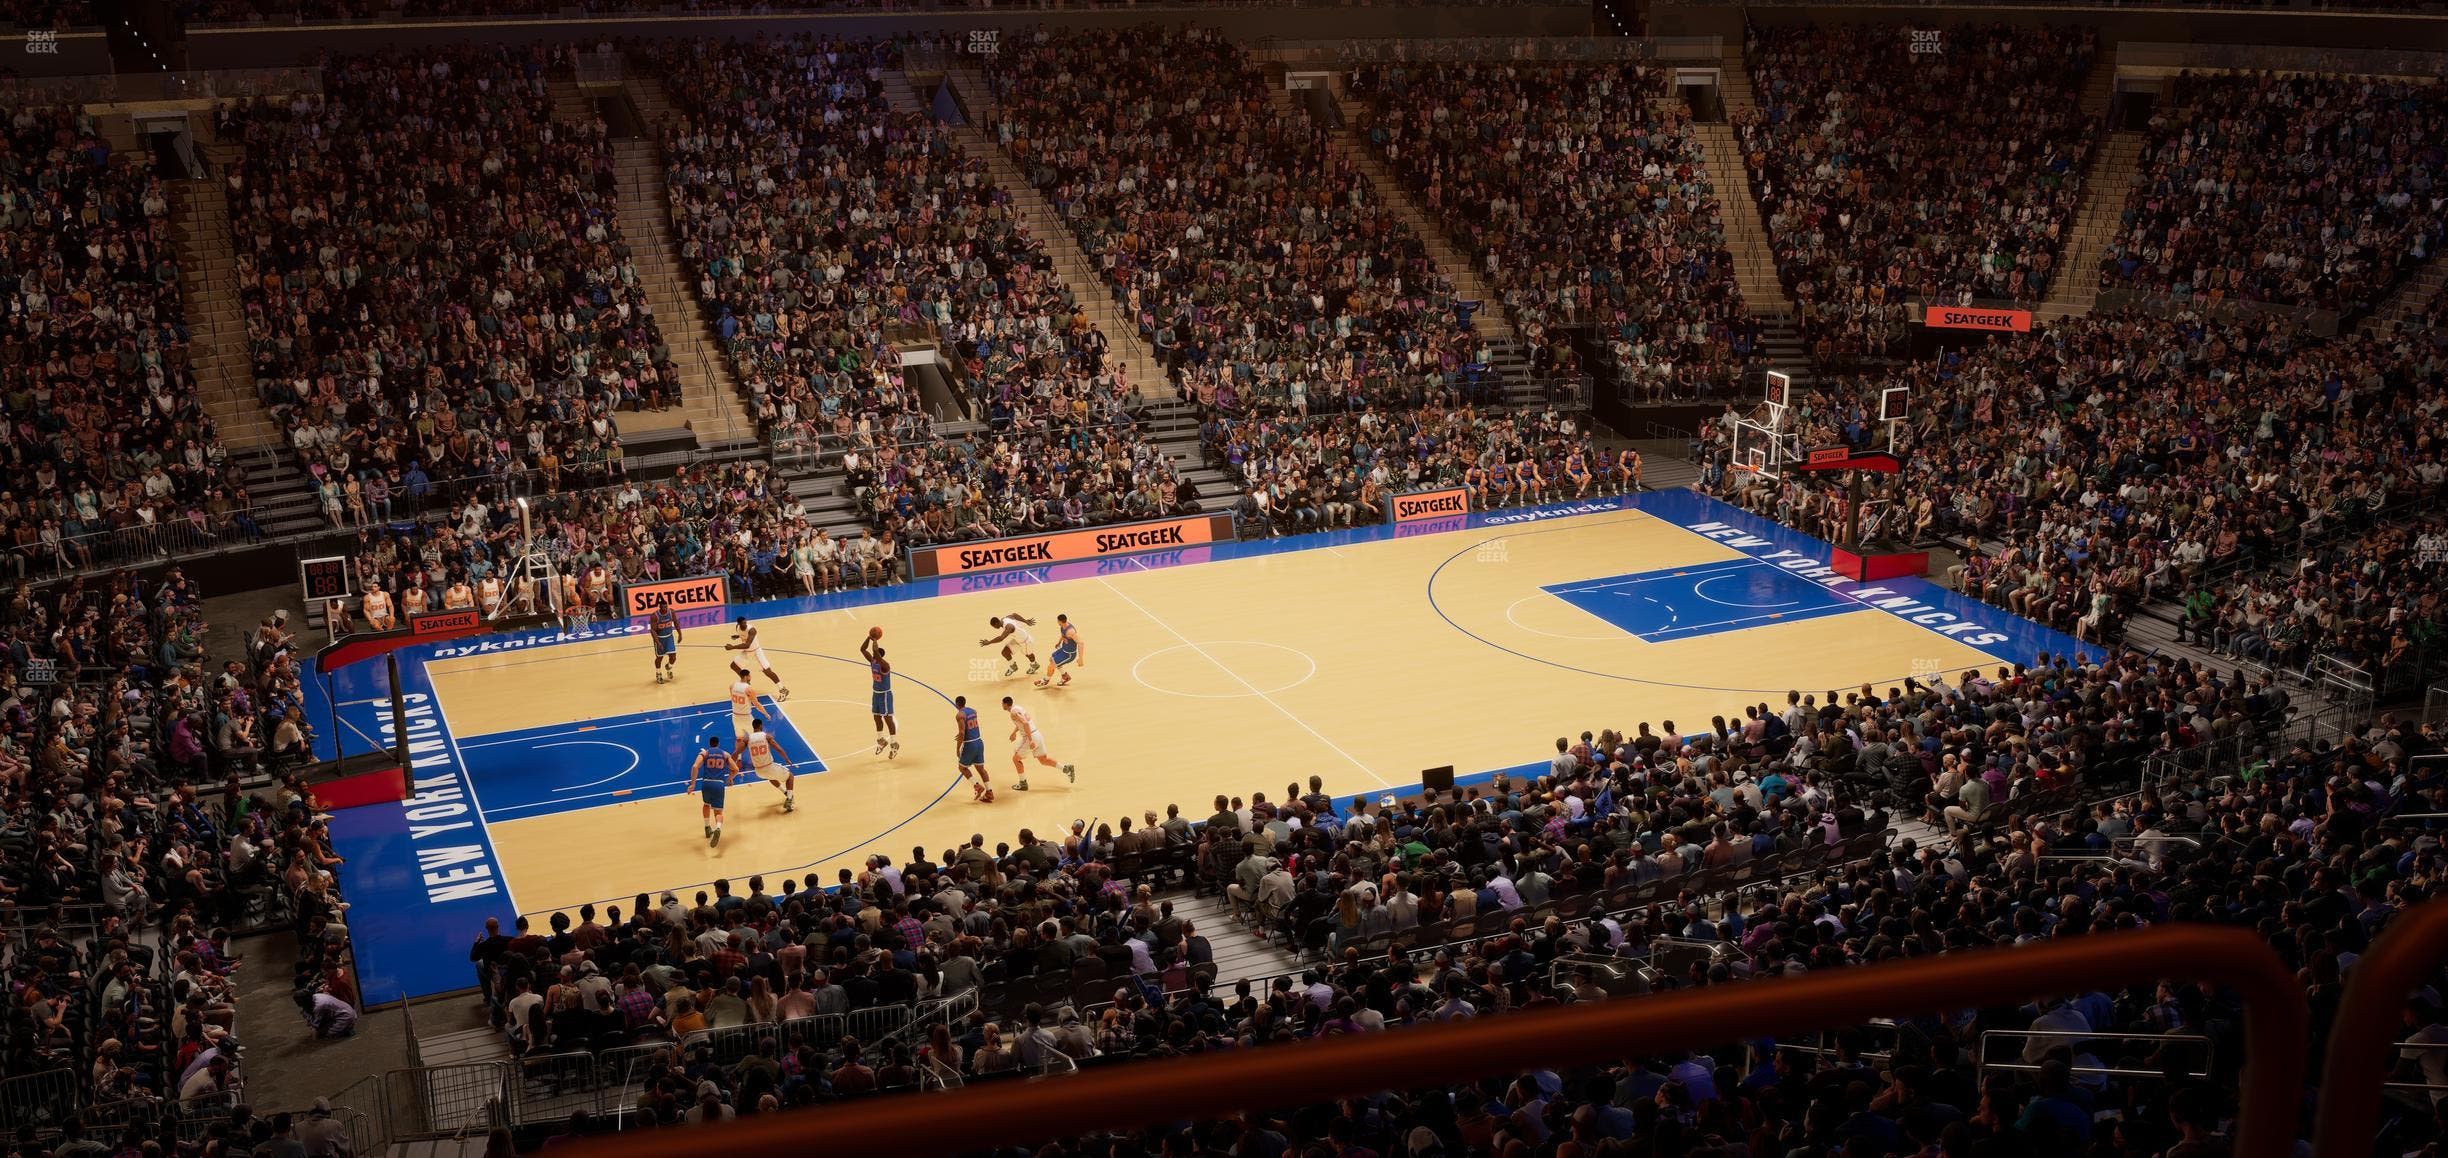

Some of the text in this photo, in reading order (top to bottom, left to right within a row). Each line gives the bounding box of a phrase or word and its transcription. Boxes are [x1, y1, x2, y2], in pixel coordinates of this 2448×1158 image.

[1944, 312, 2013, 328] SEATGEEK
[1813, 450, 1844, 461] SEATGEEK
[1399, 494, 1463, 517] SEATGEEK
[1485, 502, 1618, 523] @nyknicks
[960, 525, 1184, 570] SEATGEEK SEATGEEK
[1687, 521, 2008, 646] NEW YORK KNICKS
[635, 583, 719, 611] SEATGEEK
[420, 614, 472, 631] SEATGEEK
[434, 621, 675, 658] nyknicks.co
[750, 744, 768, 756] 00
[706, 758, 725, 769] 00
[401, 772, 474, 840] YORK
[416, 844, 498, 903] NEW
